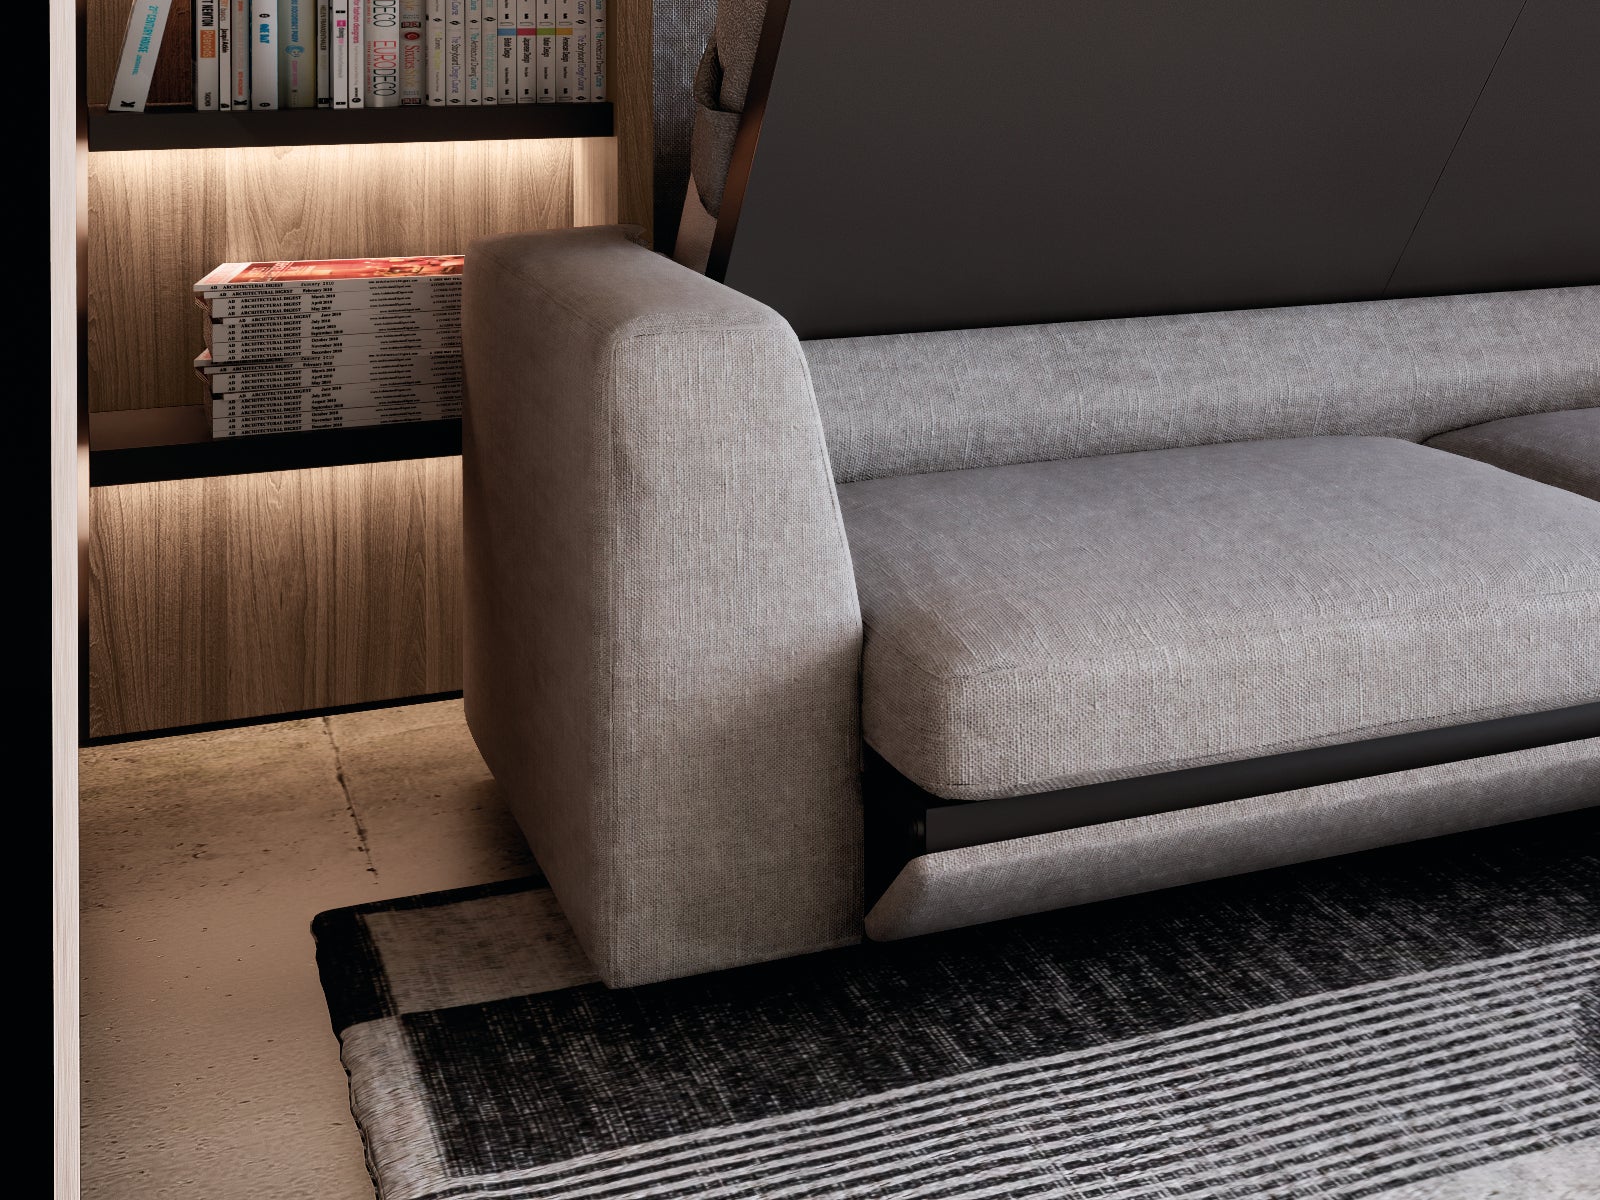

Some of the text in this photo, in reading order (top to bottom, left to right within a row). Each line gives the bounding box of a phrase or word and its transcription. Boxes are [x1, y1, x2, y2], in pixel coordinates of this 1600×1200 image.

[353, 0, 362, 7] for
[353, 6, 362, 23] fashion
[201, 4, 214, 27] NEWTON
[137, 14, 157, 54] CENTURY HOUSE
[259, 23, 270, 34] ONE
[319, 4, 327, 51] HELEN FRANKENTHALER
[351, 22, 362, 44] designers
[201, 30, 215, 58] Polaroids
[373, 40, 397, 97] EURODECO
